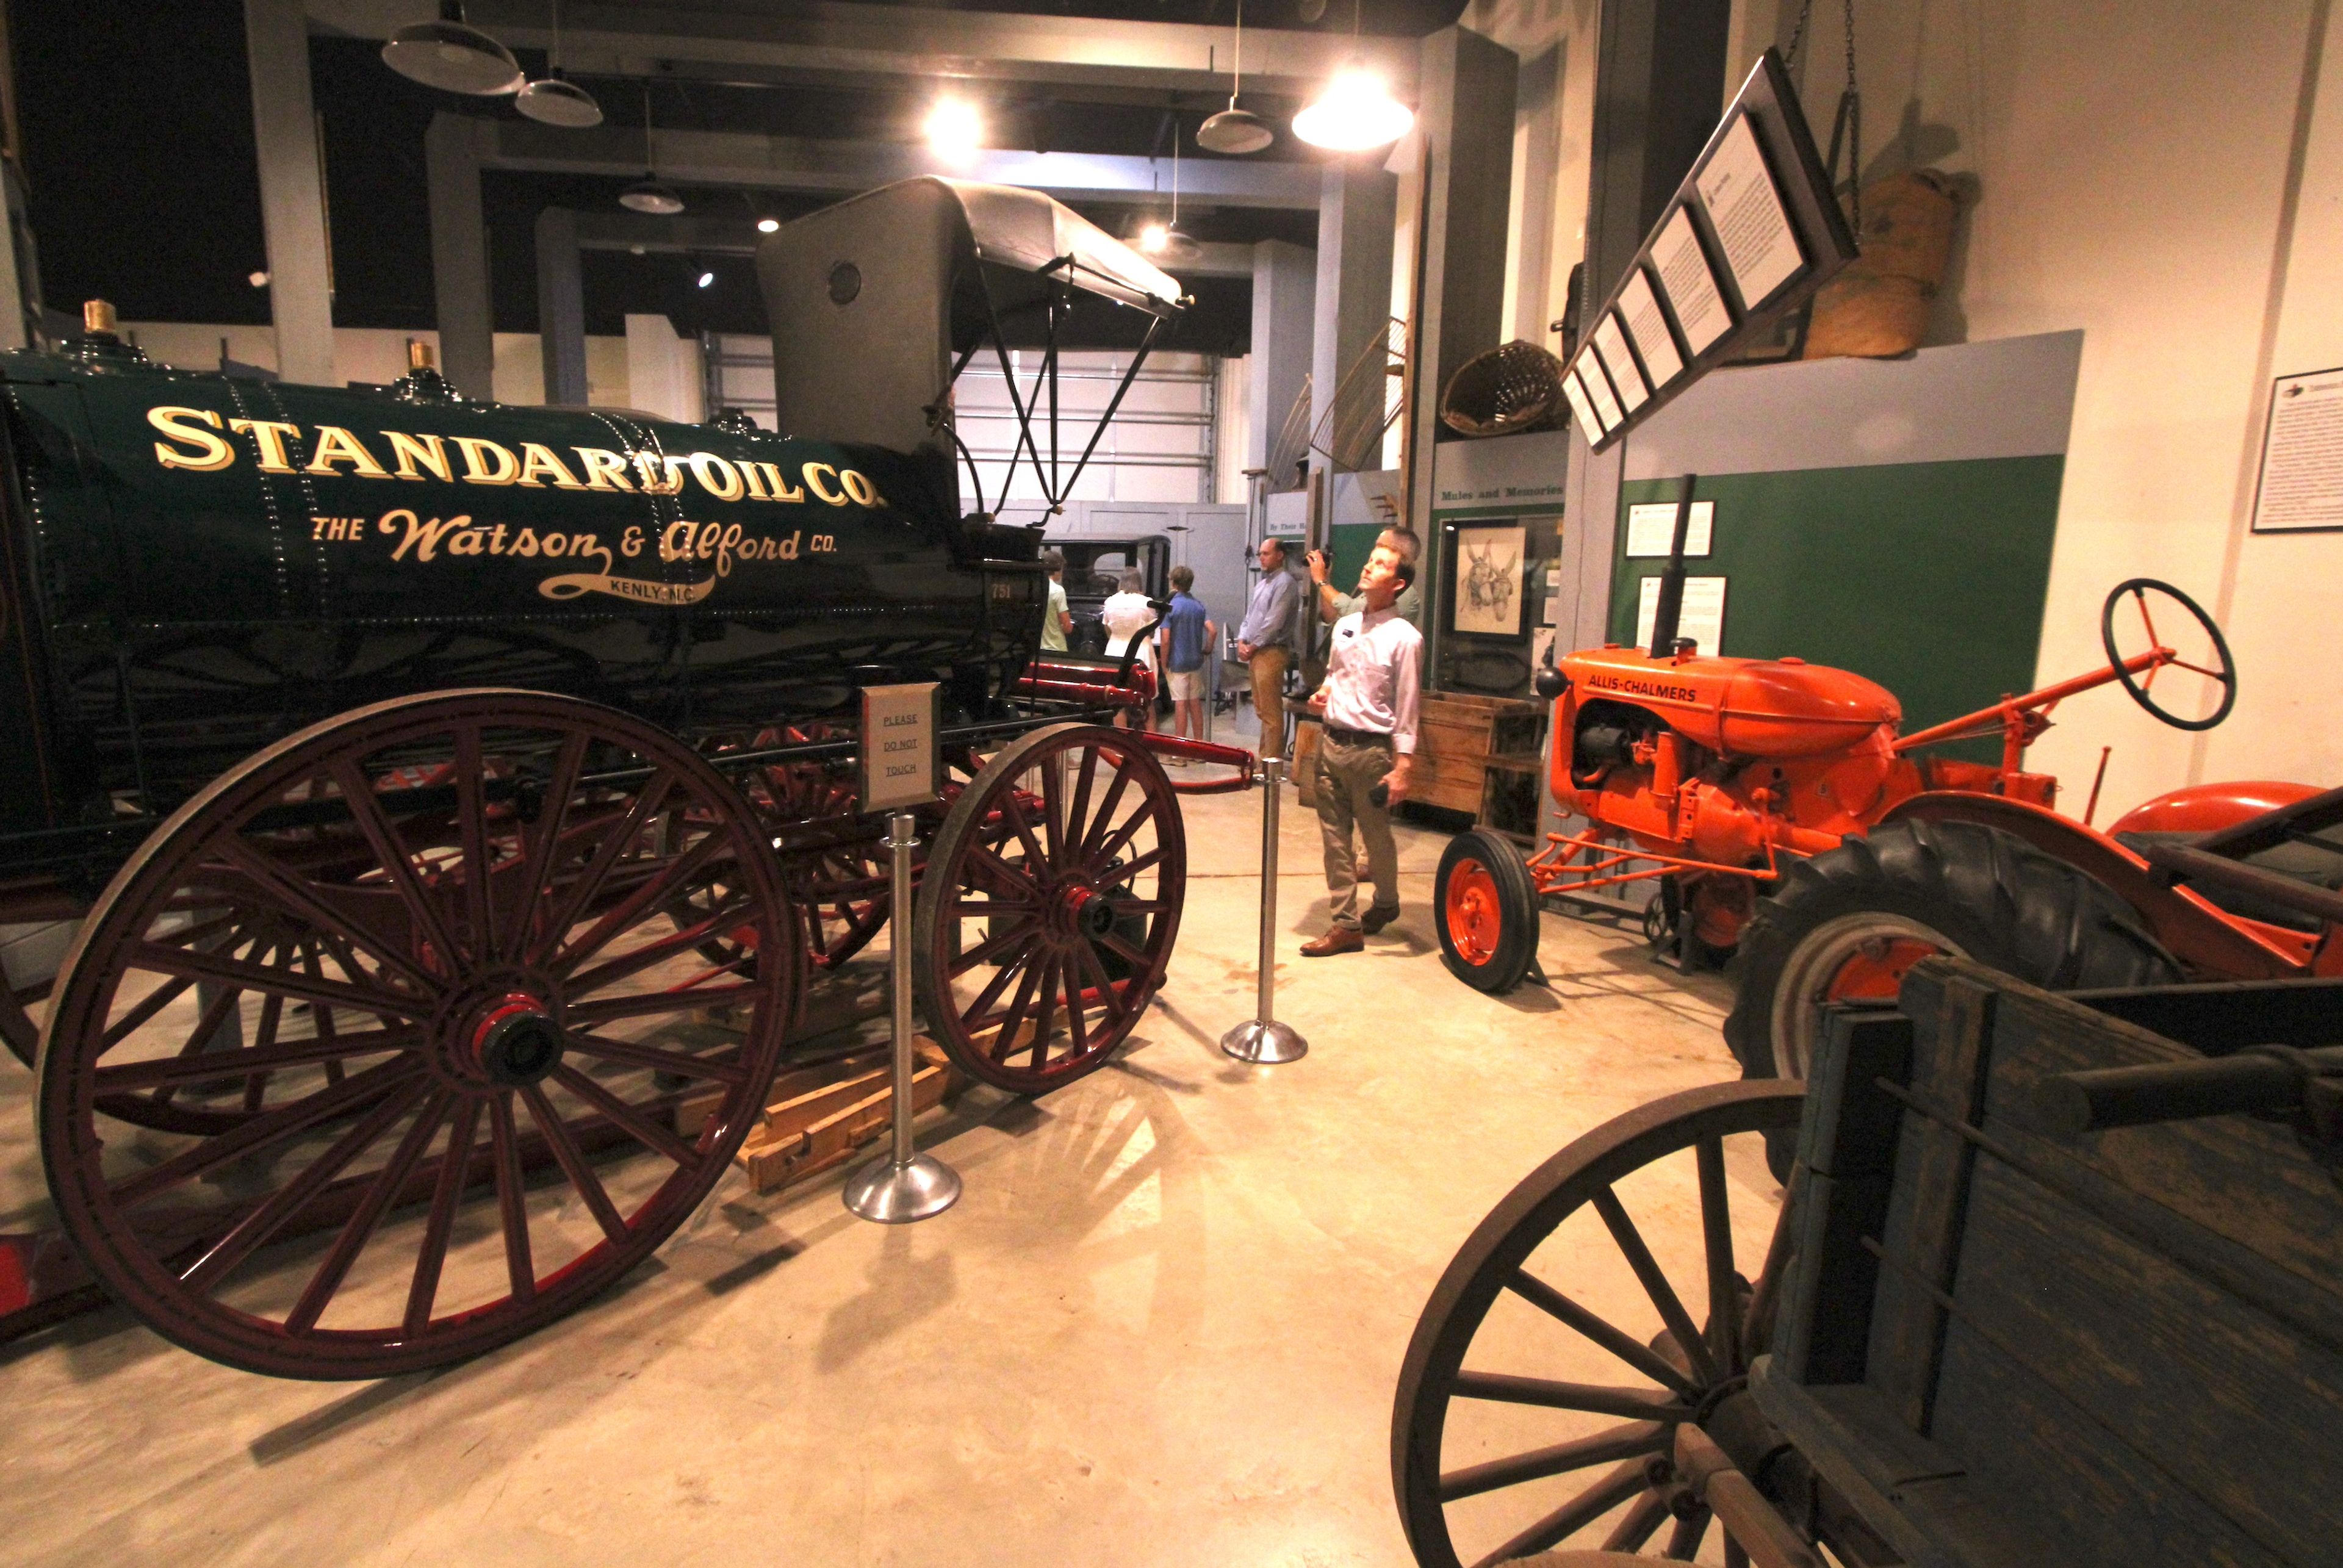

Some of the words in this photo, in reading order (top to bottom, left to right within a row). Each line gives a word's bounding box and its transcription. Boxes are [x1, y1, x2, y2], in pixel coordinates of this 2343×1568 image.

[147, 406, 683, 495] STANDARD
[688, 451, 804, 503] OIL
[1442, 490, 1473, 500] Mules
[1478, 488, 1499, 498] and
[1505, 485, 1563, 497] Memories
[311, 517, 365, 541] THE
[379, 509, 612, 565] Watson
[621, 525, 646, 556] &
[1588, 674, 1696, 702] ALLIS-CHALMERS
[884, 714, 918, 727] PLEASE
[884, 742, 897, 752] DO
[899, 739, 918, 749] NOT
[886, 764, 916, 777] TOUCH
